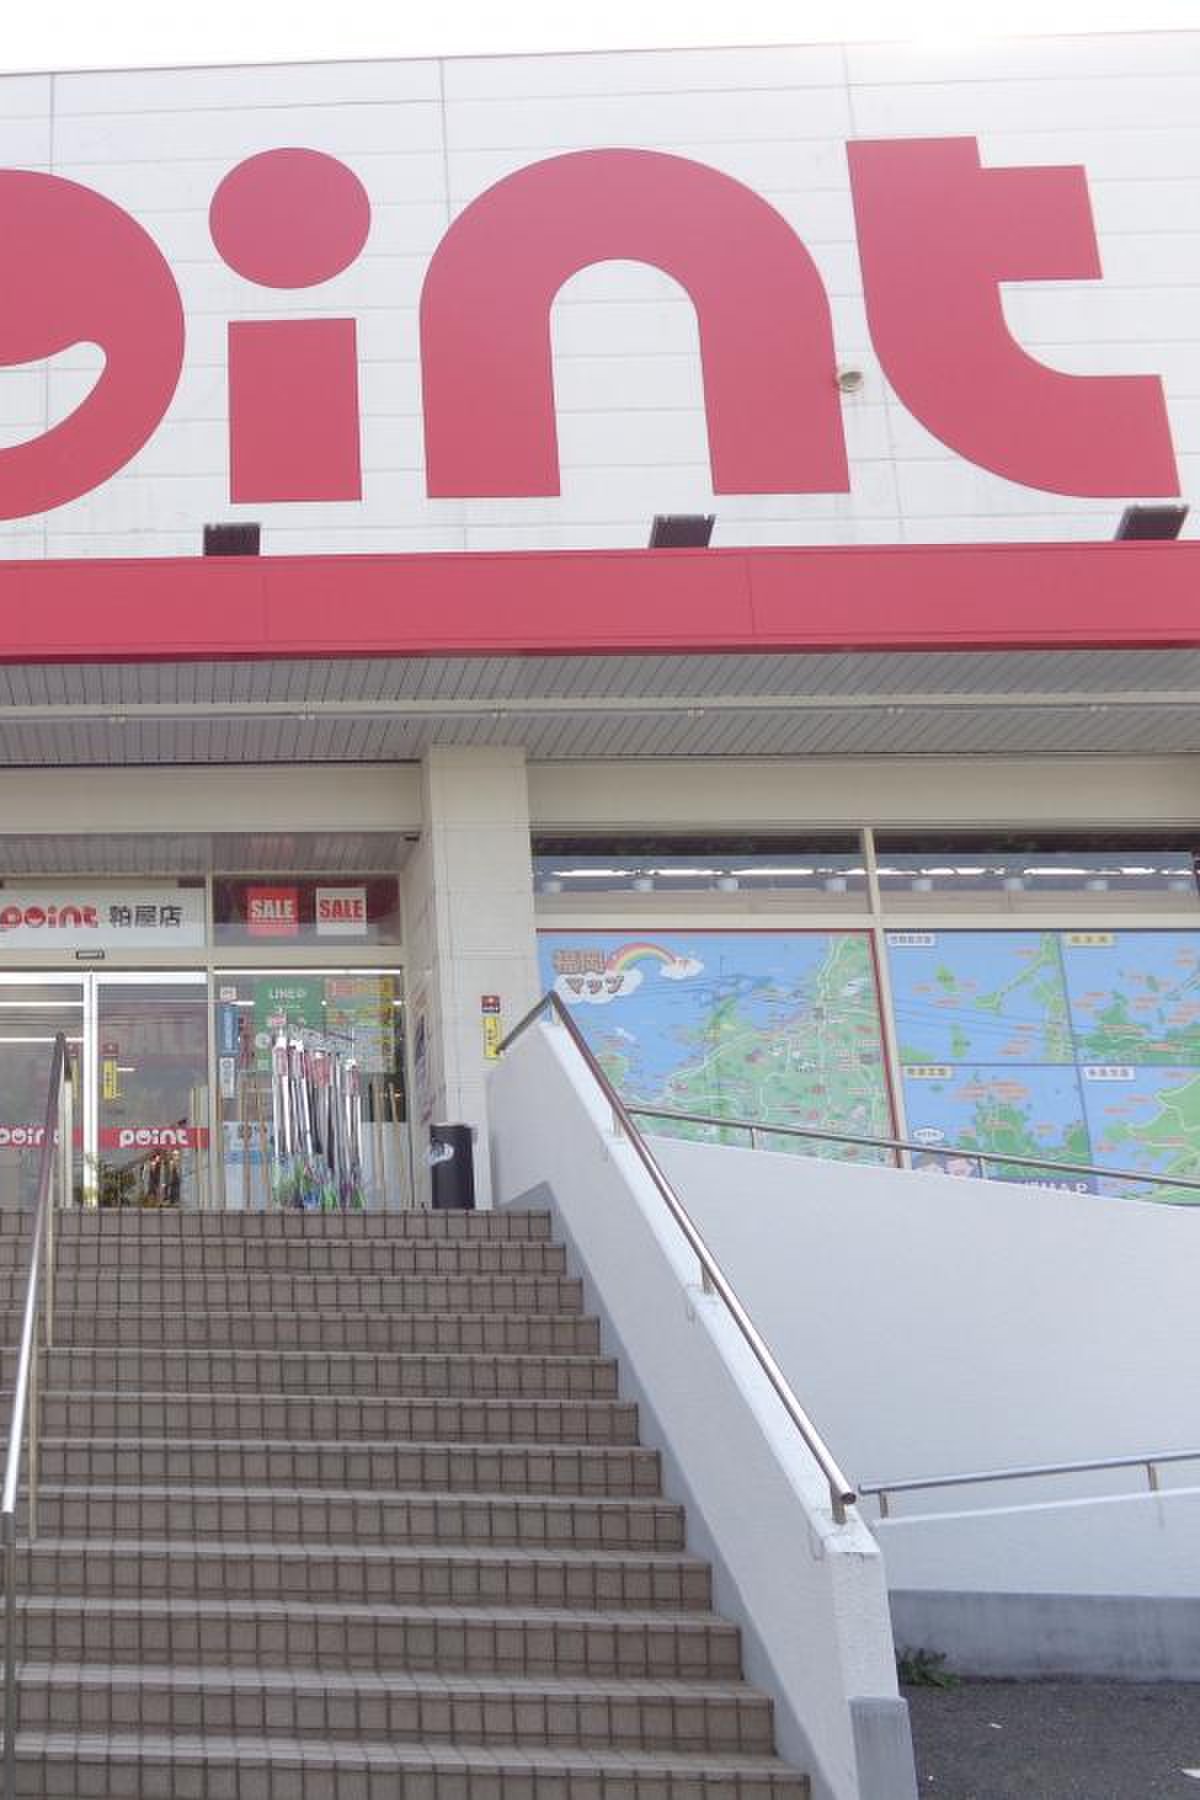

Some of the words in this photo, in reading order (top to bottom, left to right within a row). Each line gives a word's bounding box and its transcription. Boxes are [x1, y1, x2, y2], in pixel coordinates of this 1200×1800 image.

[0, 906, 98, 932] point
[109, 905, 183, 928] 粕屋店
[250, 899, 296, 919] SALE
[319, 899, 364, 919] SALE
[118, 1128, 189, 1148] point
